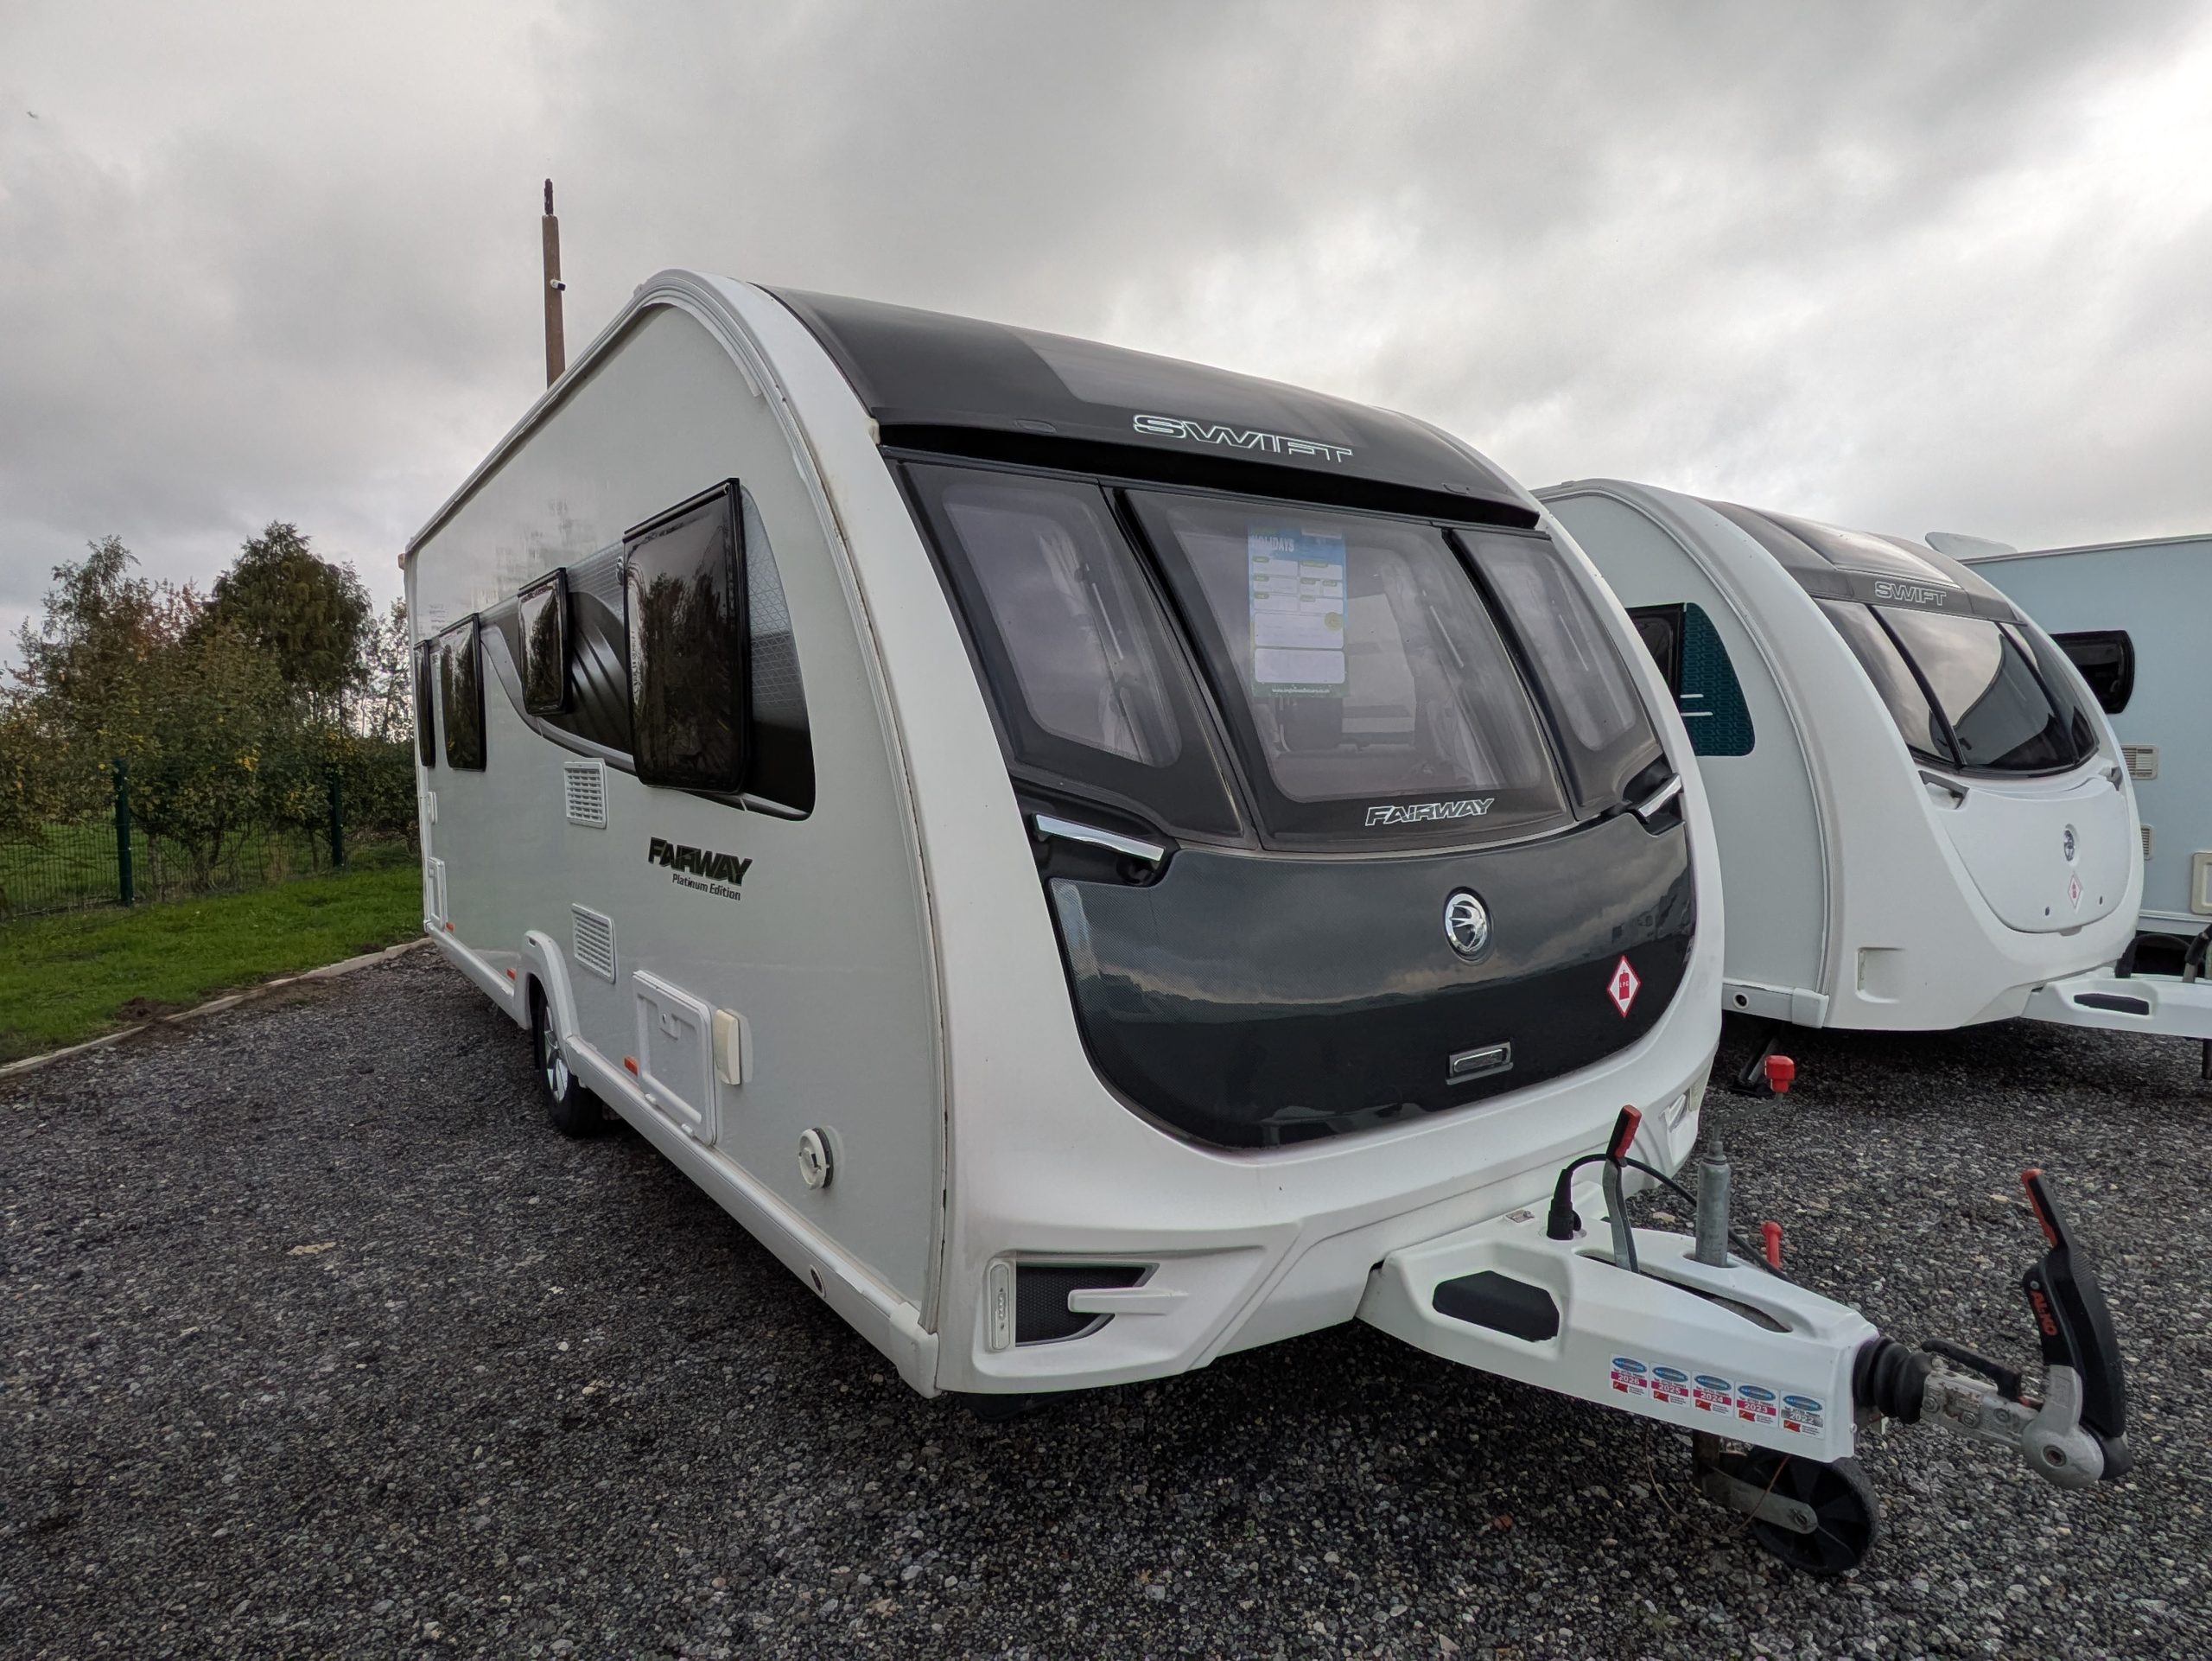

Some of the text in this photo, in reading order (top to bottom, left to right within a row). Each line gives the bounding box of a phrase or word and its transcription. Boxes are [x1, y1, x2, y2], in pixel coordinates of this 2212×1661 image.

[1133, 414, 1353, 462] SWIFT
[1874, 581, 1947, 606] SWIFT
[1365, 798, 1495, 826] FAIRWAY
[648, 837, 753, 887] FAIRWAY
[672, 873, 741, 901] Platinum Edition
[1658, 1383, 1681, 1395] 2025
[1700, 1391, 1724, 1403] 2024
[1745, 1402, 1768, 1414] 2023
[1789, 1411, 1815, 1424] 2022
